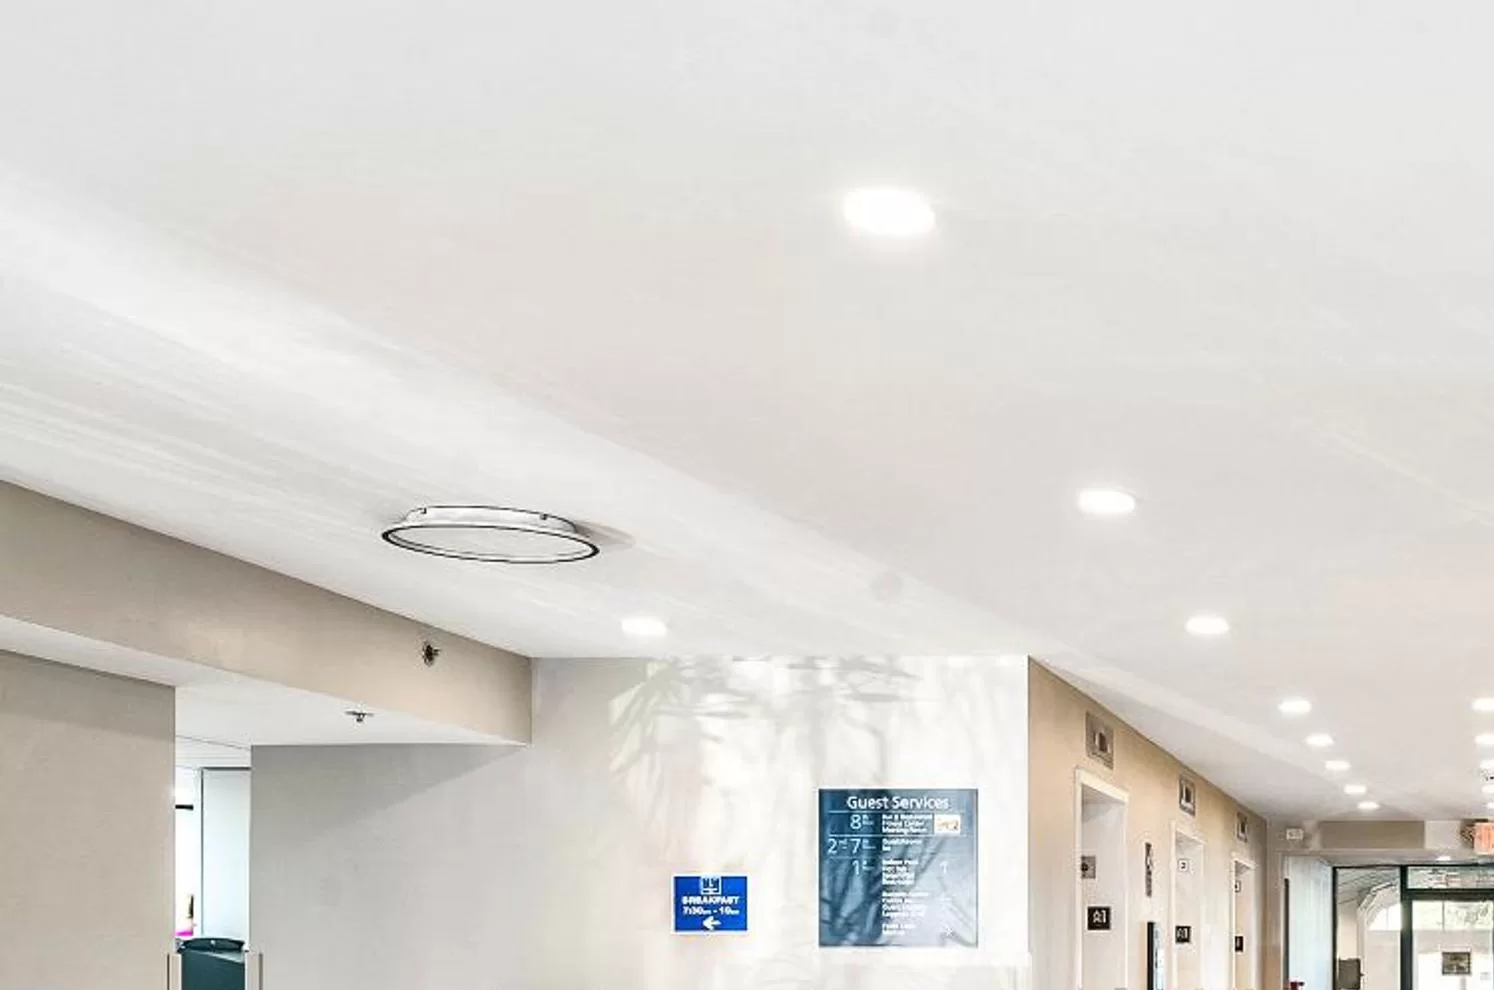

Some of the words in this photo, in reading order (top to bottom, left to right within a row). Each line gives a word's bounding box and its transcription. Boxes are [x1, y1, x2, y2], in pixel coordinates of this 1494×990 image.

[846, 795, 888, 810] Guest
[891, 795, 950, 810] Services
[681, 895, 740, 905] BREAKFAST
